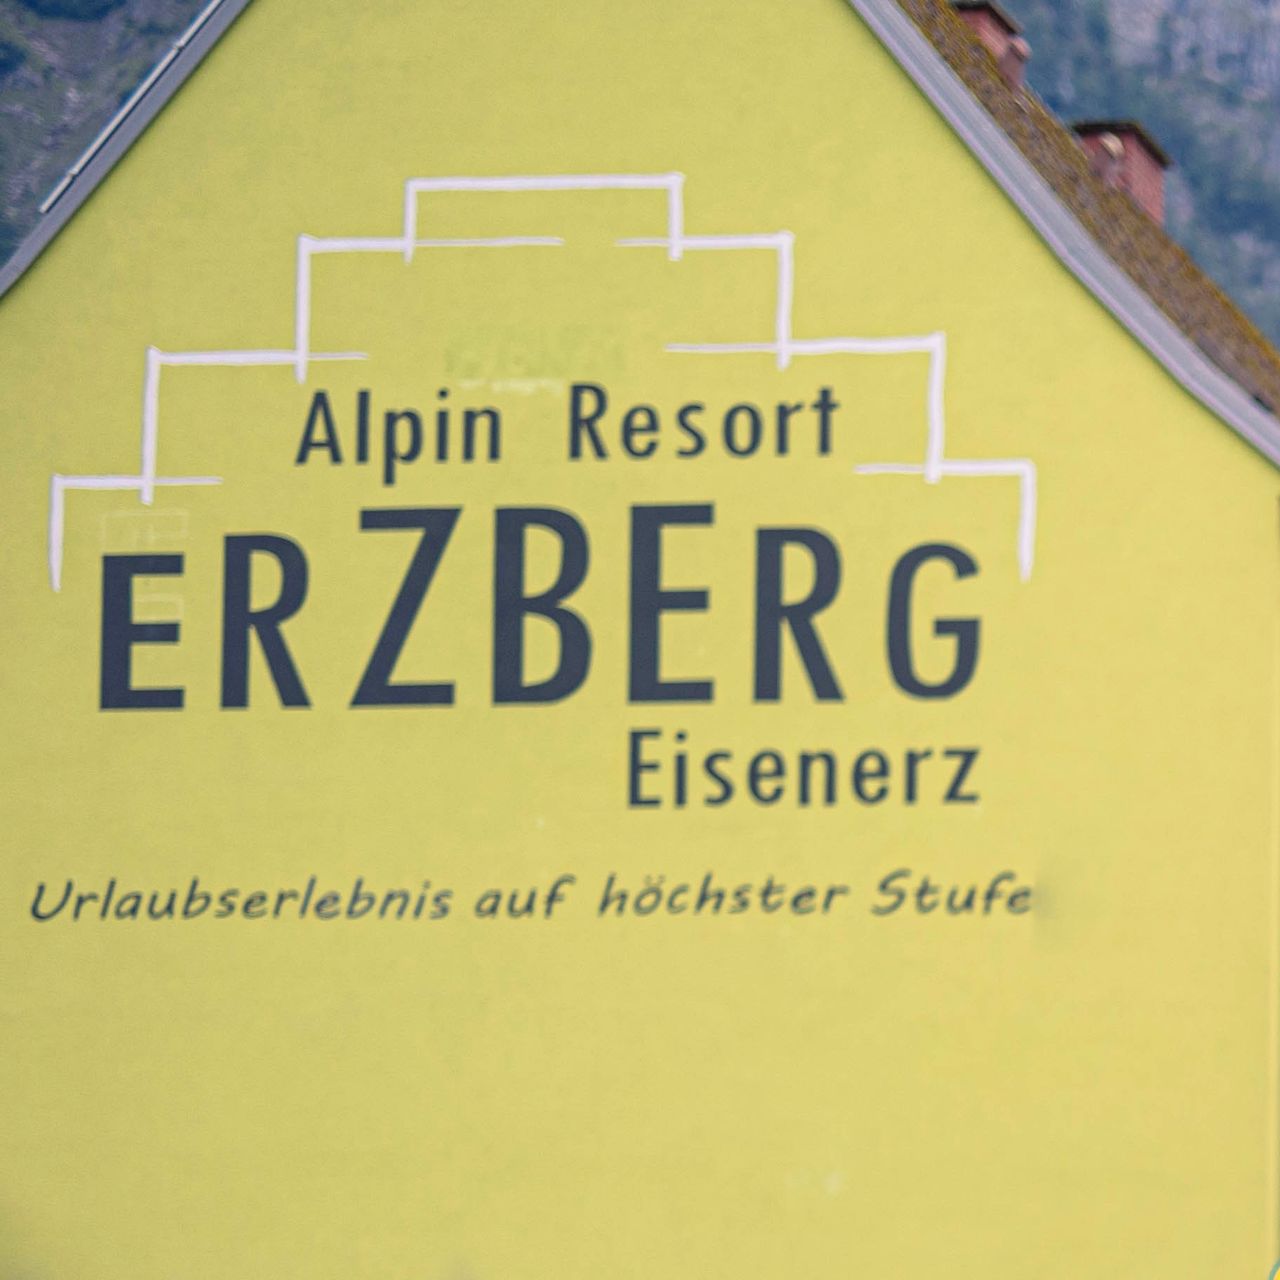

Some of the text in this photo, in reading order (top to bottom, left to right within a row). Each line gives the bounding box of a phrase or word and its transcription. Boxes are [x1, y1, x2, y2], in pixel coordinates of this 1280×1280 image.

[293, 381, 841, 488] Alpin Resort
[97, 502, 983, 714] ERZBERG
[627, 727, 981, 809] Eisenerz
[29, 869, 1034, 922] Urlaubserlebnis auf höchster Stufe
